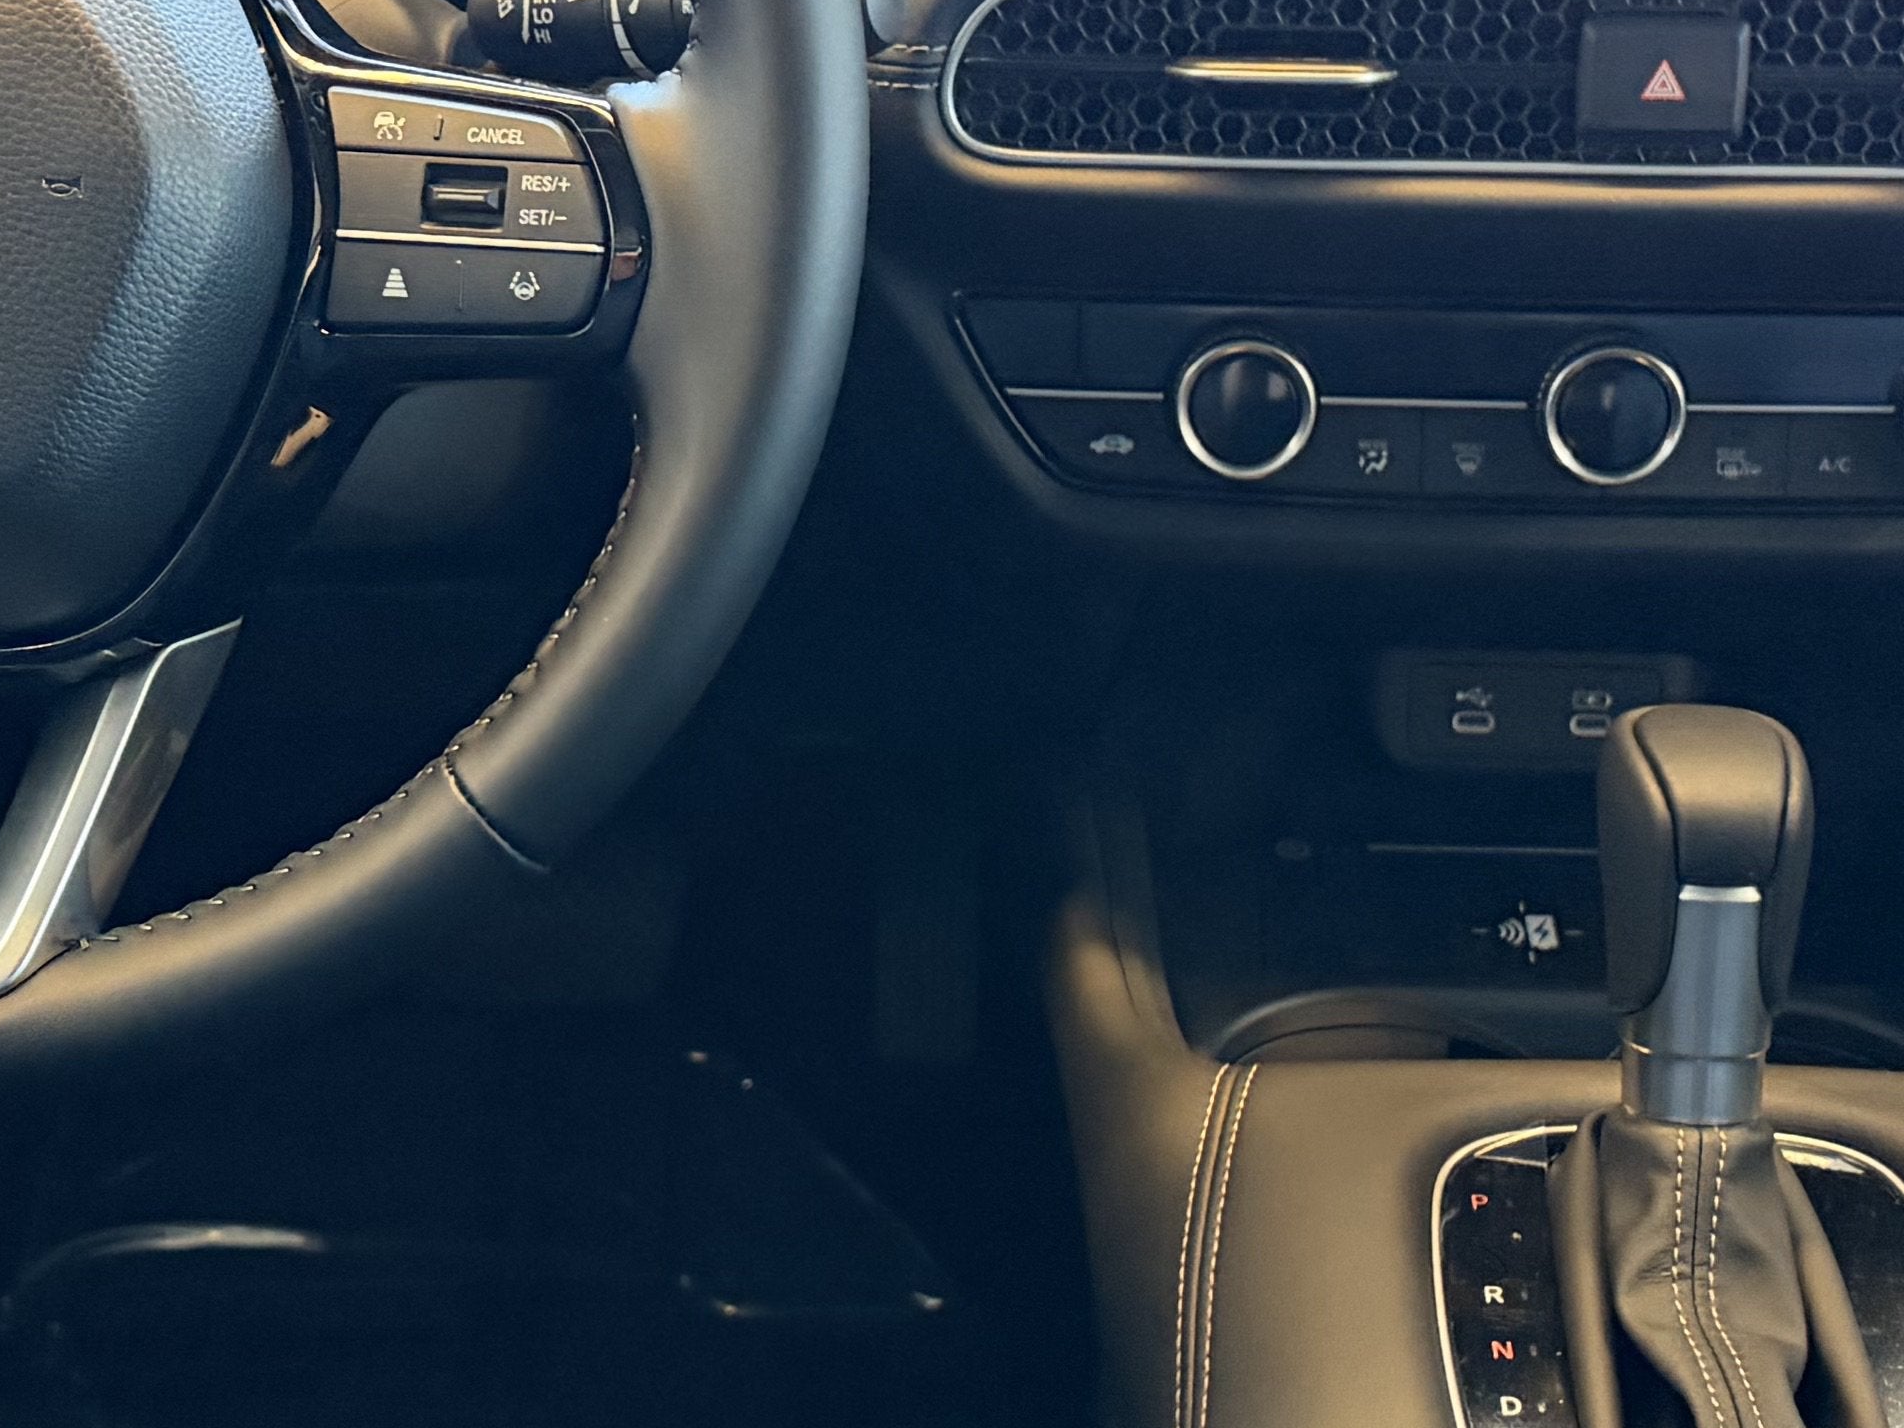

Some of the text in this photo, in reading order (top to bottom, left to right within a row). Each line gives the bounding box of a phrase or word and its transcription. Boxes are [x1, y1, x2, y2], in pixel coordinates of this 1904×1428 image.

[532, 7, 554, 24] LO
[533, 28, 552, 43] HI
[467, 127, 525, 145] CANCEL
[1471, 1193, 1489, 1211] P
[1484, 1285, 1504, 1304] R
[1491, 1340, 1515, 1360] N
[1500, 1396, 1523, 1416] D
